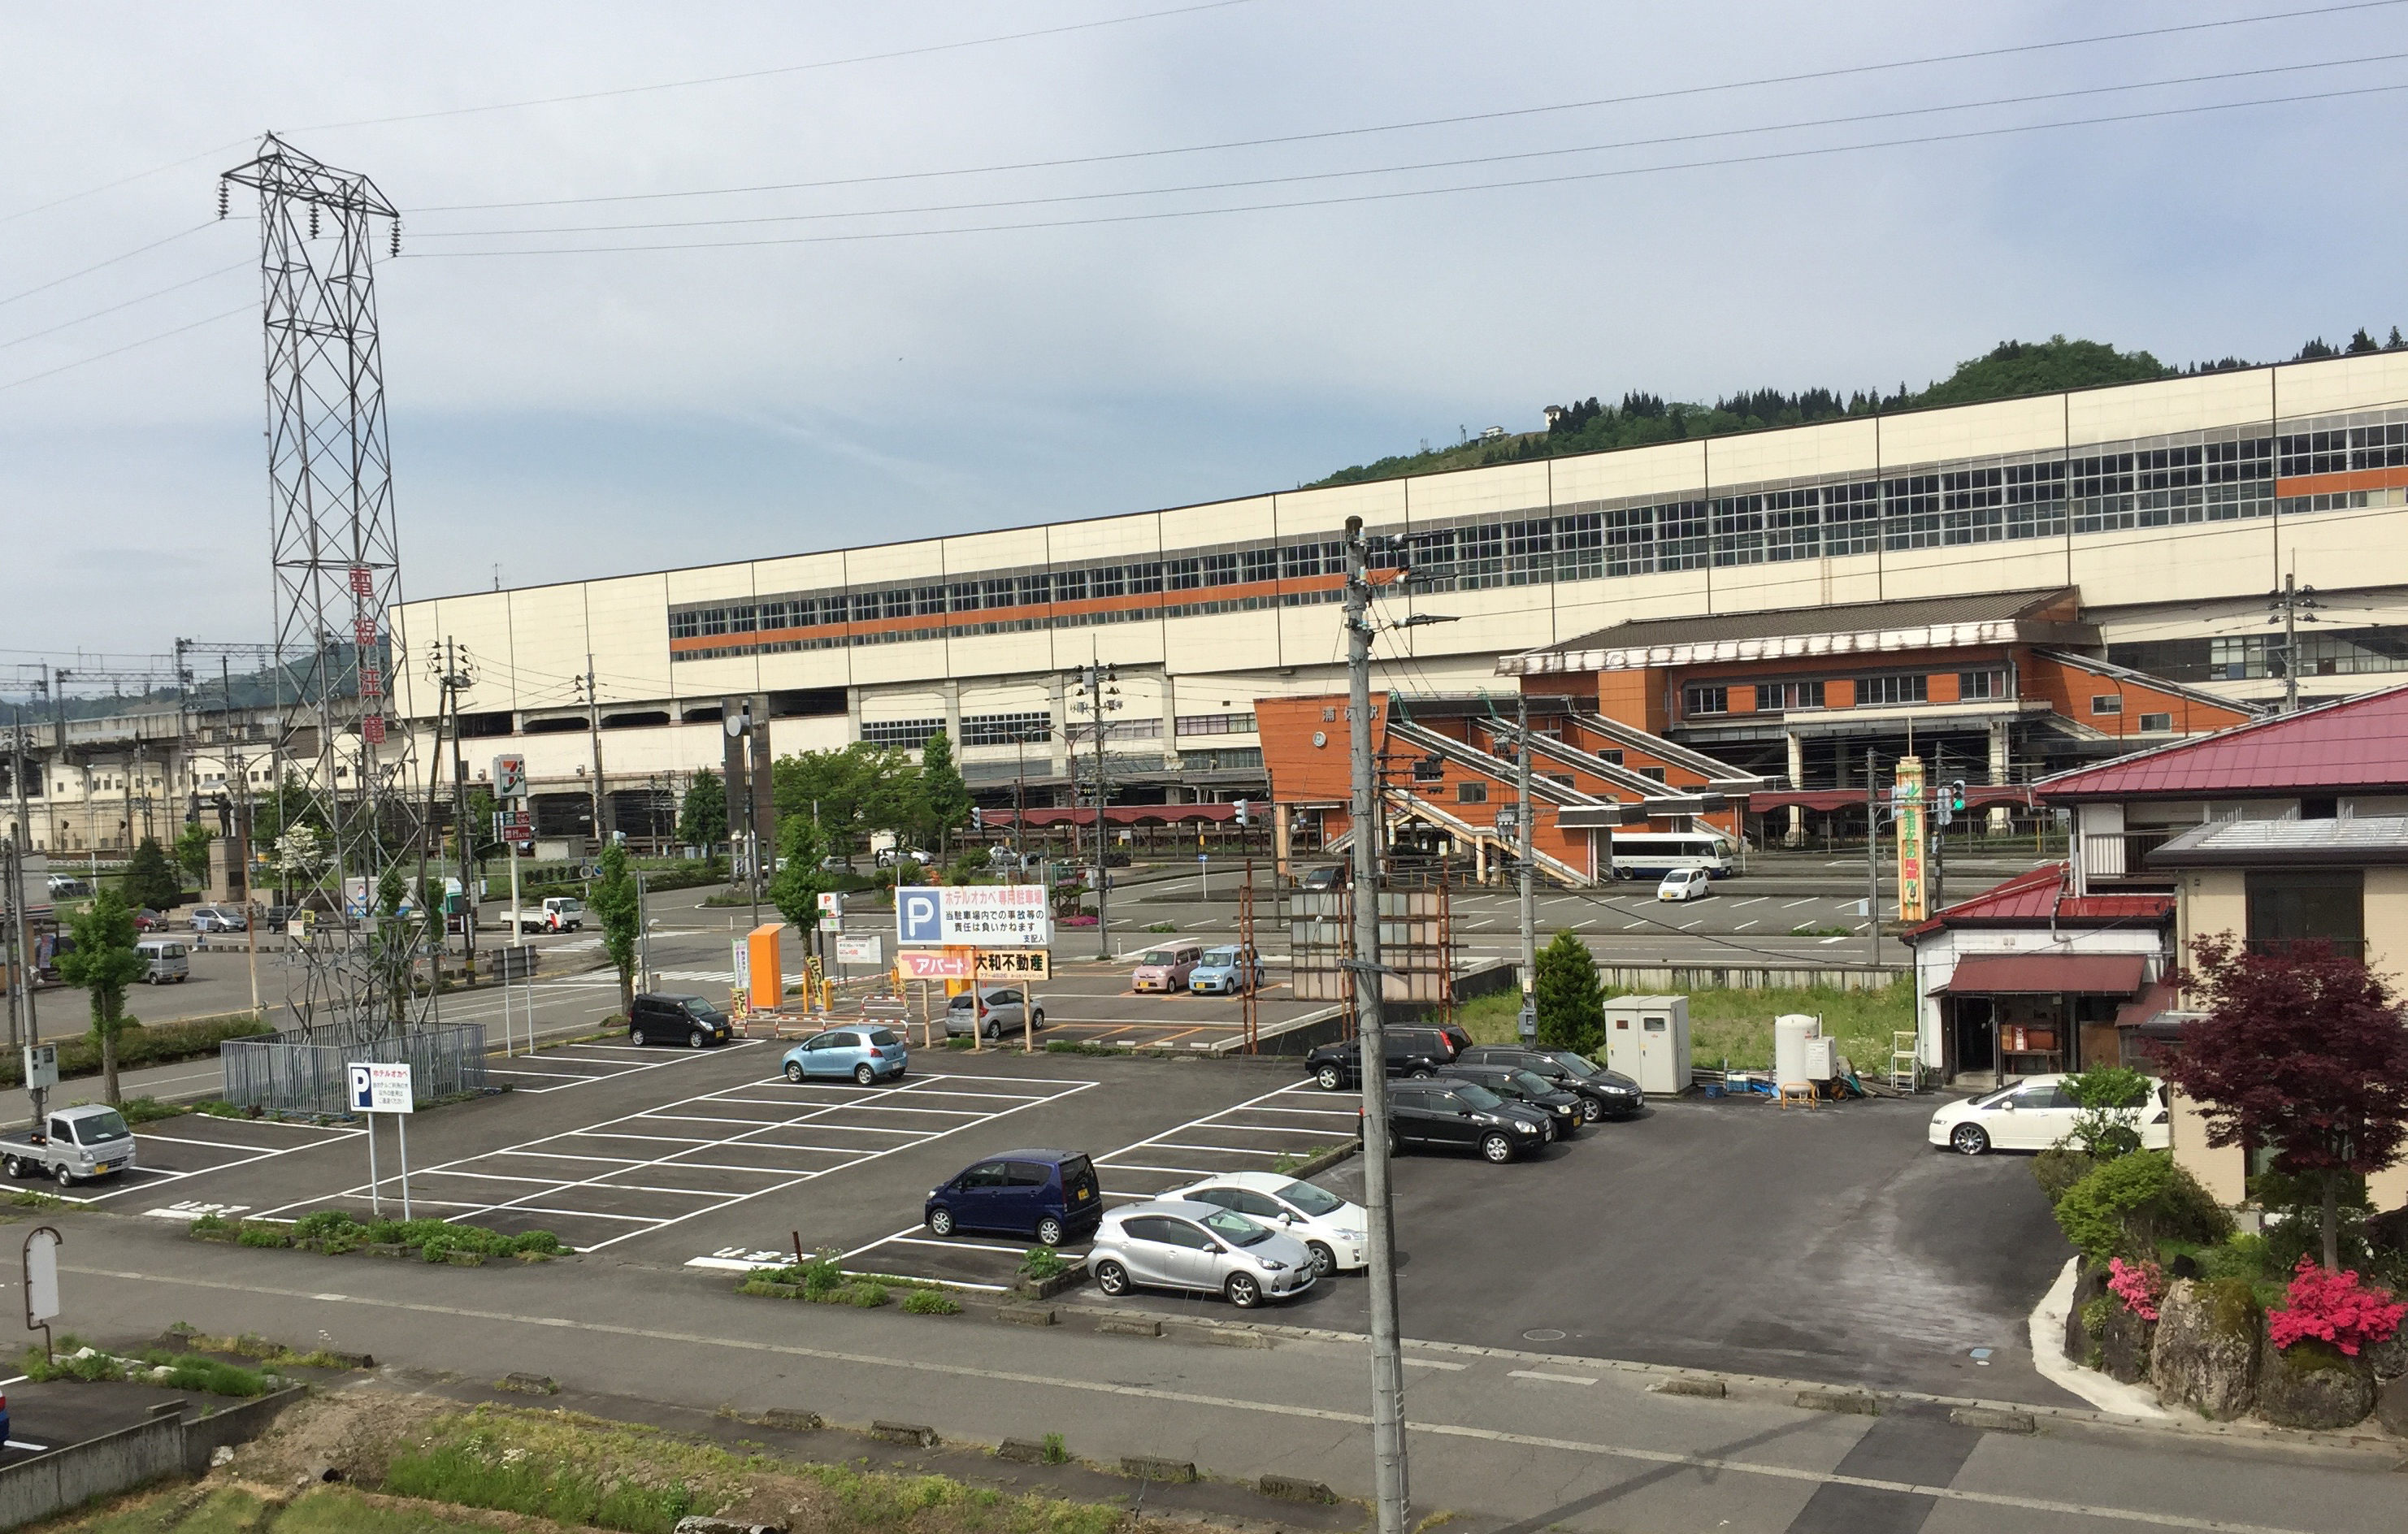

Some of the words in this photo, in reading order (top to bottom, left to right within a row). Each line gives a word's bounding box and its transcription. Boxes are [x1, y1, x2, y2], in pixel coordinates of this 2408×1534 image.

[907, 897, 934, 937] P
[945, 910, 1044, 921] 当駐車場内での事故等の
[954, 922, 1035, 932] 責任は負いかねます
[1023, 934, 1045, 943] 支配人
[916, 958, 964, 974] アパート
[974, 954, 1043, 972] 大和不動産
[351, 1068, 370, 1107] P
